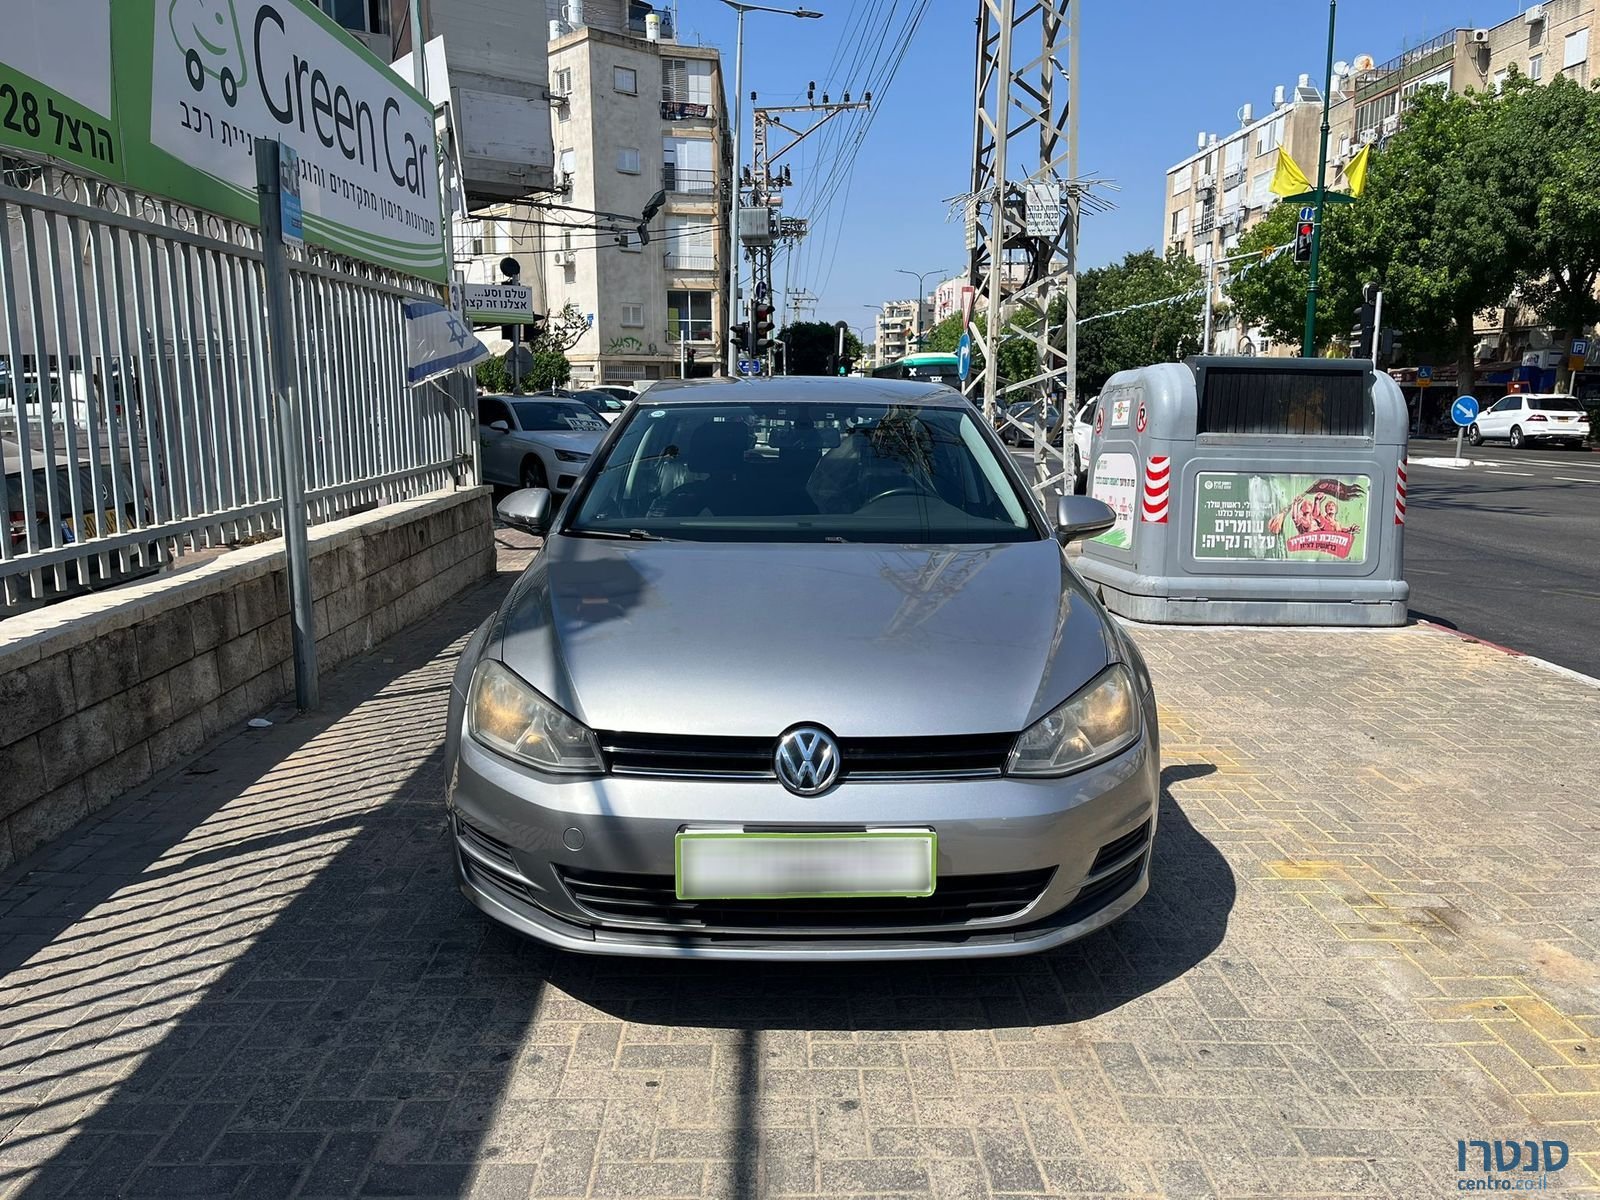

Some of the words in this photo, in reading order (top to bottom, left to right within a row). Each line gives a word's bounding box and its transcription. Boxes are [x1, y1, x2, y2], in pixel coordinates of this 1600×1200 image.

[0, 83, 40, 138] 28
[254, 4, 378, 173] Green
[382, 96, 428, 200] Car
[47, 98, 114, 164] הרצל
[179, 100, 214, 140] רכב
[329, 172, 378, 212] מתקדמים
[379, 196, 403, 222] מימון
[405, 209, 435, 237] פתרונות
[486, 299, 497, 308] זה
[500, 298, 527, 310] אצלנו
[504, 288, 527, 299] שלם
[1214, 519, 1265, 534] שומרים
[1234, 509, 1245, 518] של
[1202, 534, 1241, 551] נקייה!
